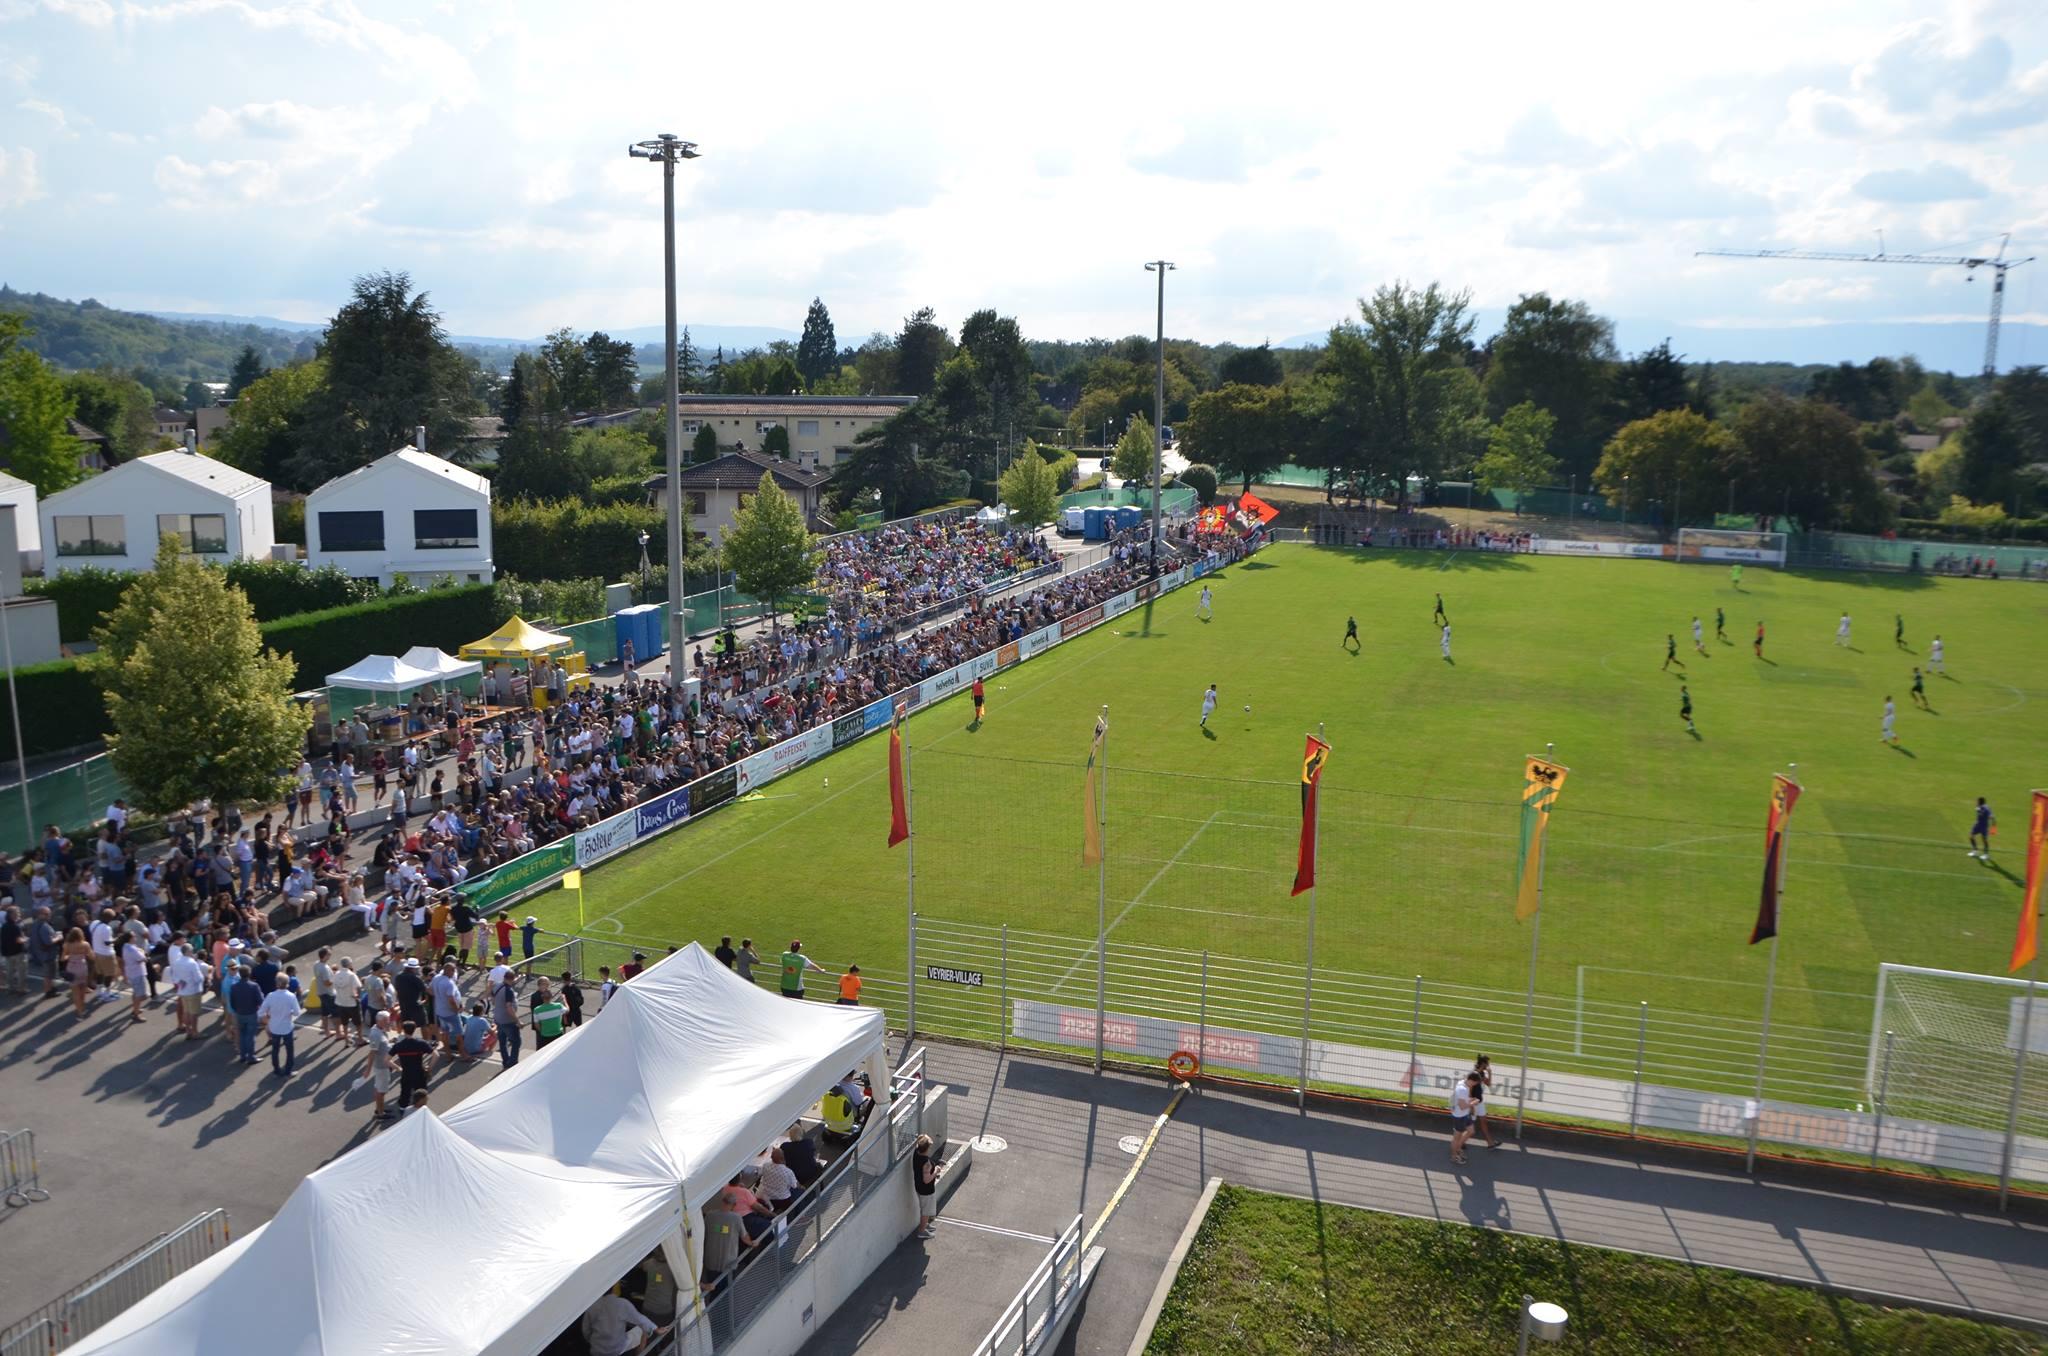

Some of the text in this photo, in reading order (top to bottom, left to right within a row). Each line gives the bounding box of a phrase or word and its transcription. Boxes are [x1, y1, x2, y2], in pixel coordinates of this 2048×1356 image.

[774, 740, 807, 761] RAIFFEISEN
[503, 867, 529, 885] JAUNE
[538, 853, 557, 868] VERT
[928, 966, 982, 985] VEYRIER-VILLAGE
